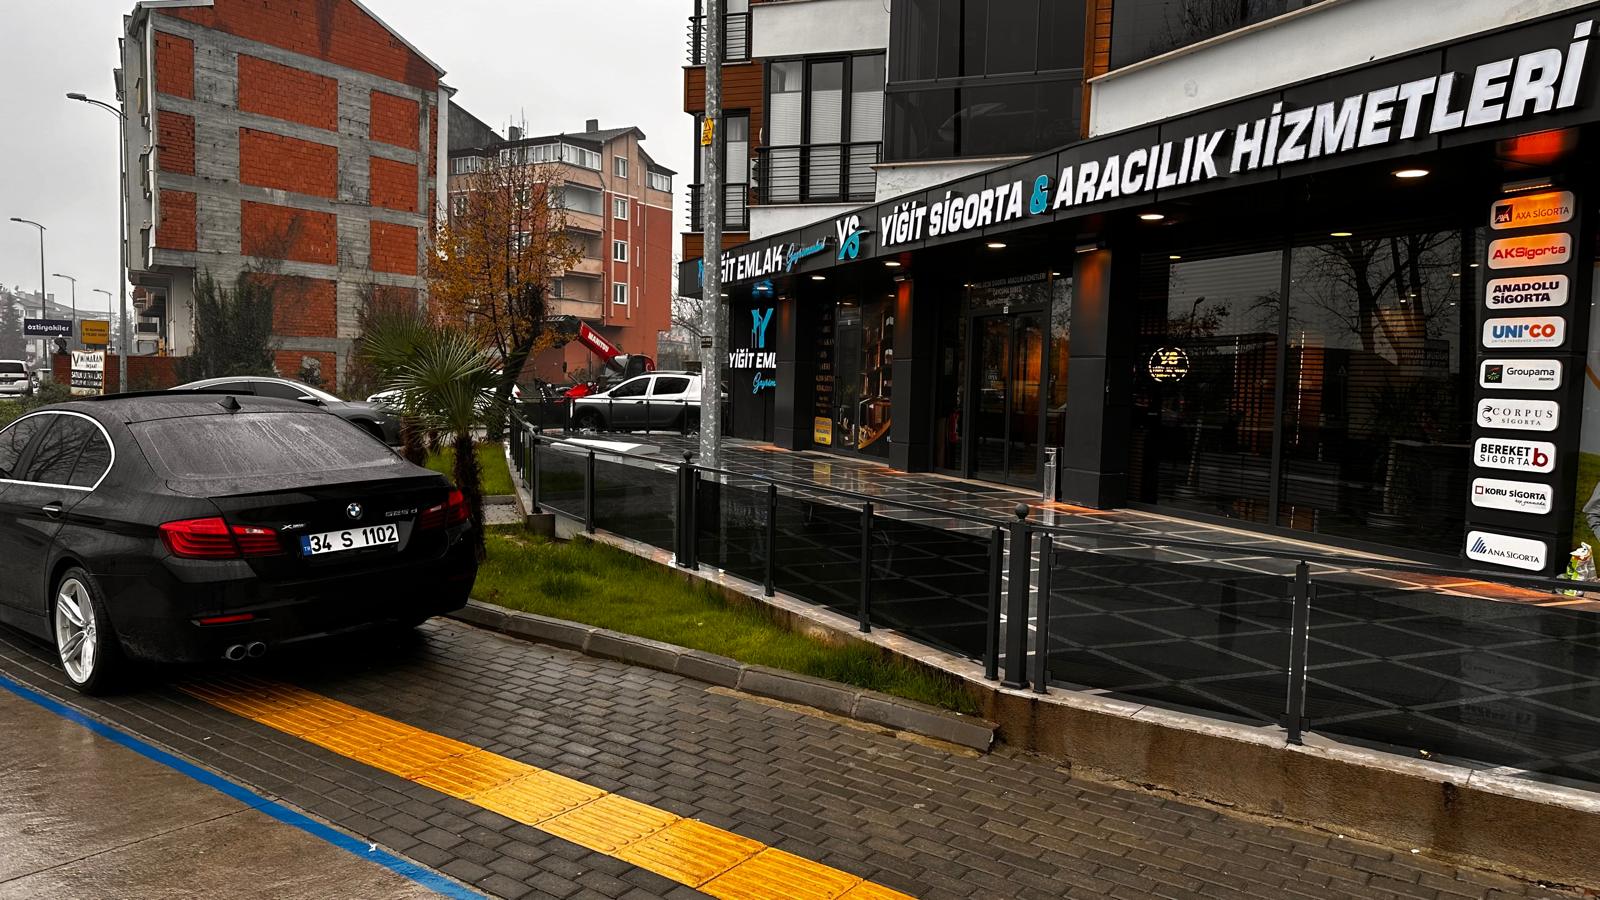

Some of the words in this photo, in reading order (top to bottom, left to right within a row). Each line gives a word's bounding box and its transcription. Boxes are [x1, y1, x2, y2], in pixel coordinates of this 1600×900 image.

[881, 201, 927, 247] YİĞİT
[929, 180, 1023, 237] SİGORTA
[1029, 174, 1049, 215] &
[1053, 129, 1225, 210] ARACILIK
[1229, 19, 1593, 174] HİZMETLERİ
[1516, 211, 1532, 220] AXA
[1533, 206, 1570, 218] SİGORTA
[1492, 246, 1566, 260] AKSigorta
[737, 244, 784, 280] EMLAK
[1493, 281, 1560, 293] ANADOLU
[1492, 293, 1551, 305] SİGORTA
[729, 348, 755, 369] YİĞİT
[755, 352, 777, 369] EML
[1506, 367, 1555, 377] Groupama
[1492, 407, 1553, 418] CORPUS
[1501, 418, 1541, 426] SİGORTA
[1480, 443, 1531, 457] BEREKET
[1485, 487, 1507, 496] KORU
[1509, 490, 1546, 501] SİGORTA
[310, 533, 333, 553] 34
[340, 531, 354, 548] S
[362, 526, 397, 546] 1102
[1487, 548, 1506, 558] ANA
